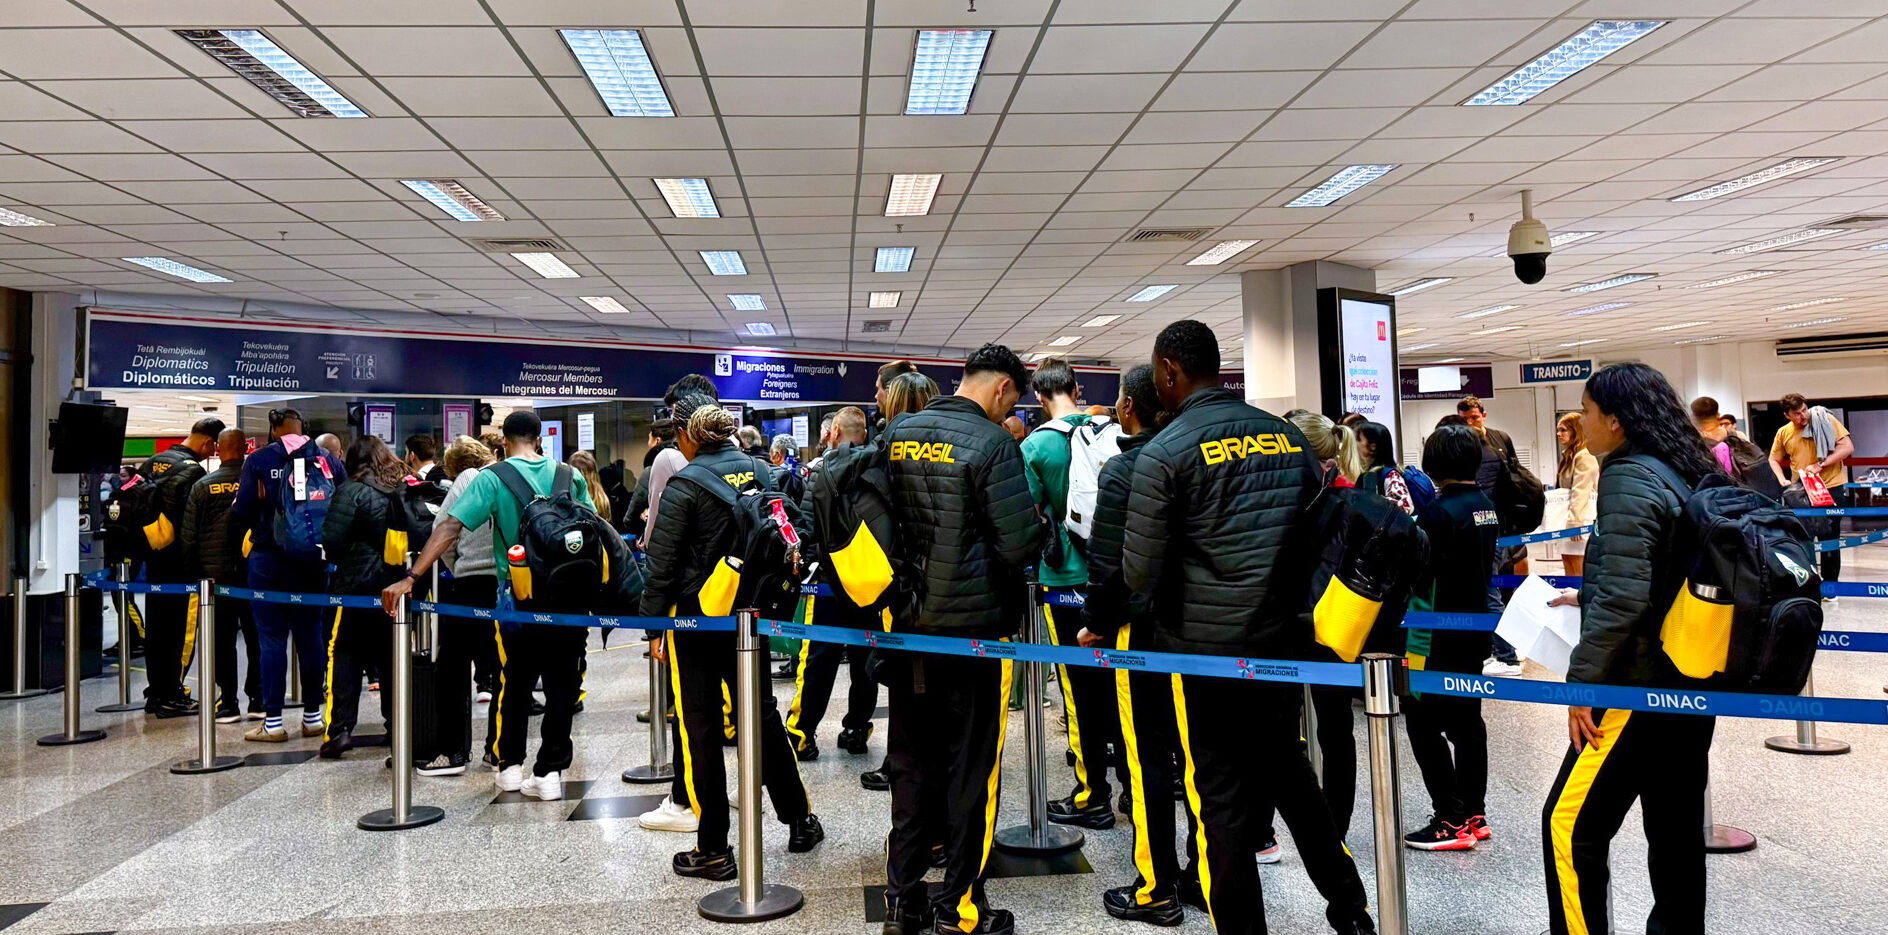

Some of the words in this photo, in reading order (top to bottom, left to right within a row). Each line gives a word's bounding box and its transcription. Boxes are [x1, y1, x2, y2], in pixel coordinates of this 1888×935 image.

[132, 355, 209, 370] Diplomatics
[235, 360, 296, 374] Tripulation
[736, 361, 785, 374] Migraciones
[794, 364, 834, 376] Immigration
[122, 371, 216, 386] Diplomáticos
[519, 371, 562, 382] Mercosur
[563, 373, 603, 384] Members
[1533, 365, 1580, 379] TRANSITO
[228, 375, 300, 389] Tripulación
[763, 378, 798, 389] Foreigners
[502, 384, 556, 396] Integrantes
[558, 385, 573, 394] del
[576, 386, 618, 396] Mercosur
[760, 389, 800, 401] Extranjeros
[890, 441, 955, 464] BRASIL
[1200, 433, 1303, 465] BRASIL
[420, 602, 436, 611] DINAC
[474, 608, 492, 618] DINAC
[534, 614, 553, 623] DINAC
[599, 617, 621, 626] DINAC
[674, 619, 698, 628] DINAC
[1255, 668, 1298, 677] MIGRACIONES
[1444, 677, 1495, 694] DINAC
[1647, 692, 1708, 710] DINAC
